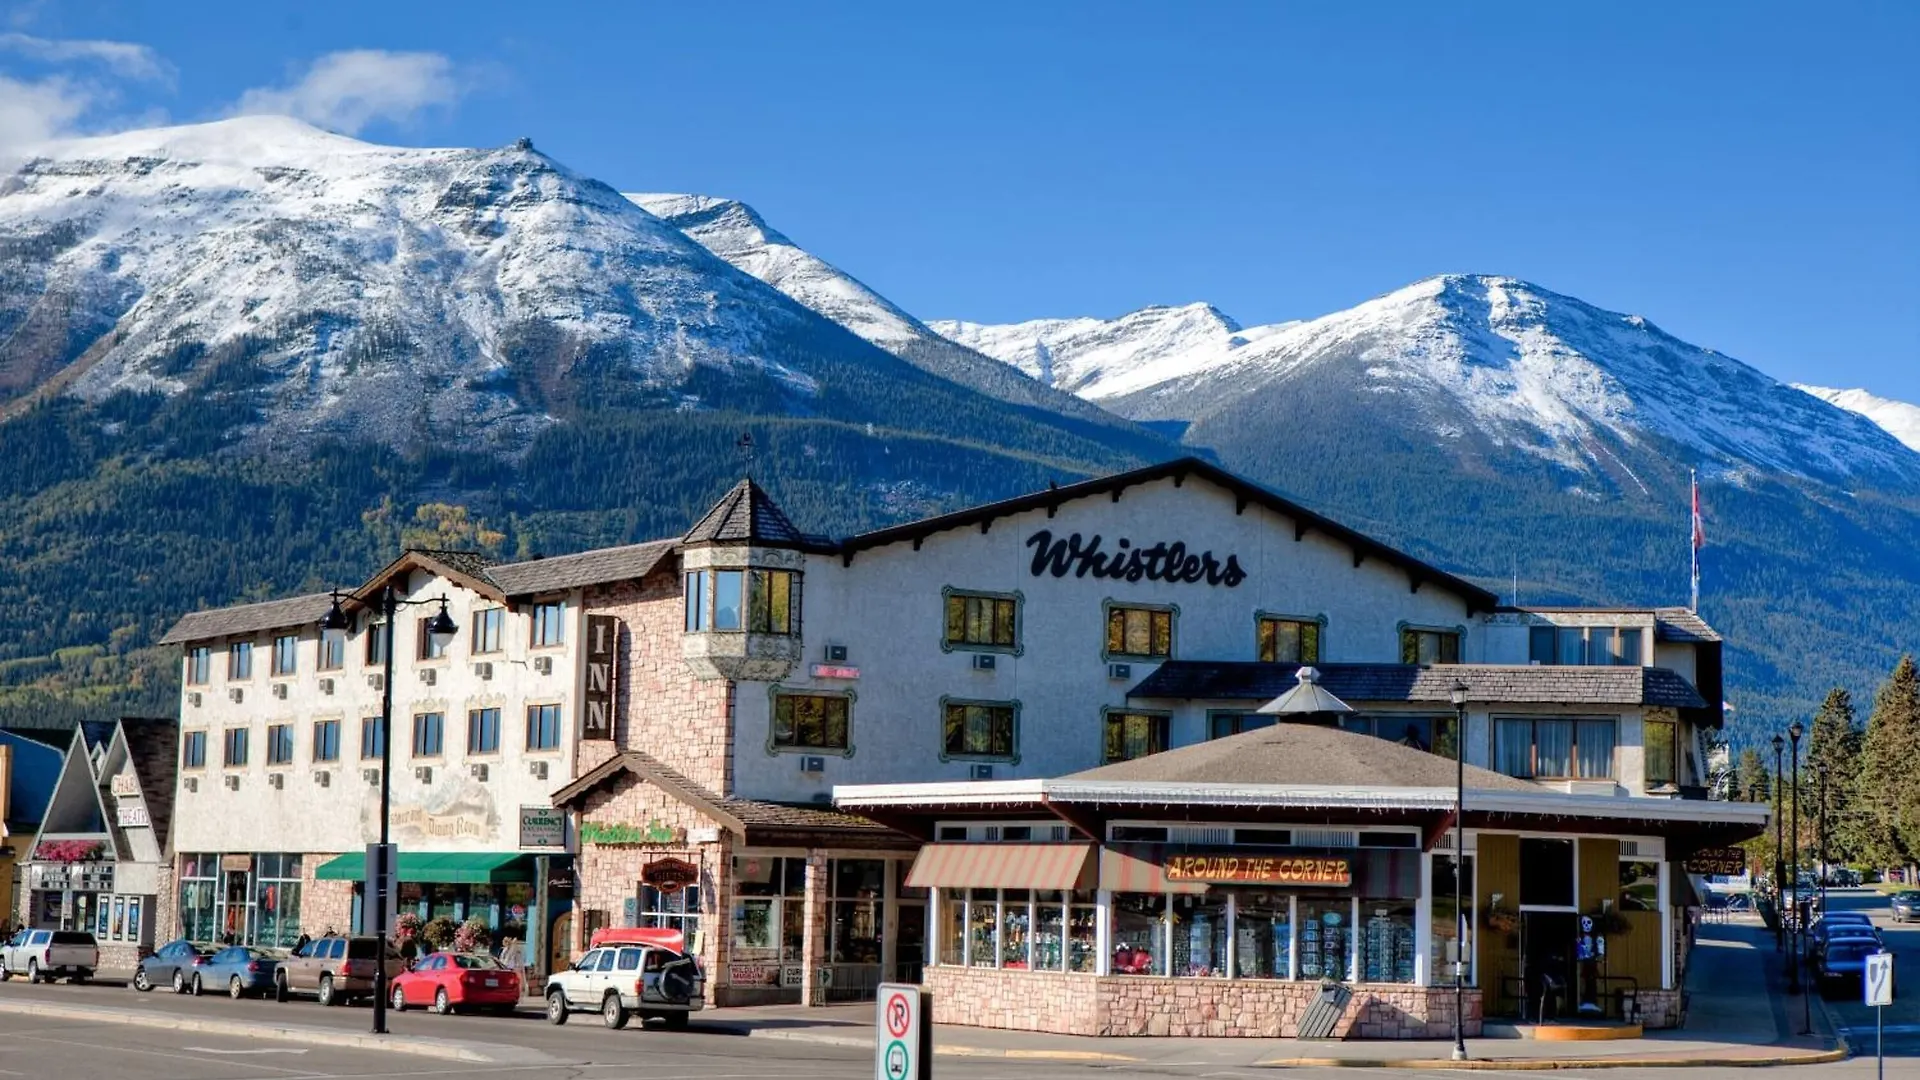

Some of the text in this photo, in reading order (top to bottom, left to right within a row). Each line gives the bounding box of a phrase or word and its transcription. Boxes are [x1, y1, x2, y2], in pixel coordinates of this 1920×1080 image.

[1026, 529, 1248, 588] Whistlers
[587, 625, 610, 729] INN
[523, 815, 562, 826] CURRENCY
[1168, 856, 1347, 881] AROUND THE CORNER
[1688, 858, 1743, 875] CORNER
